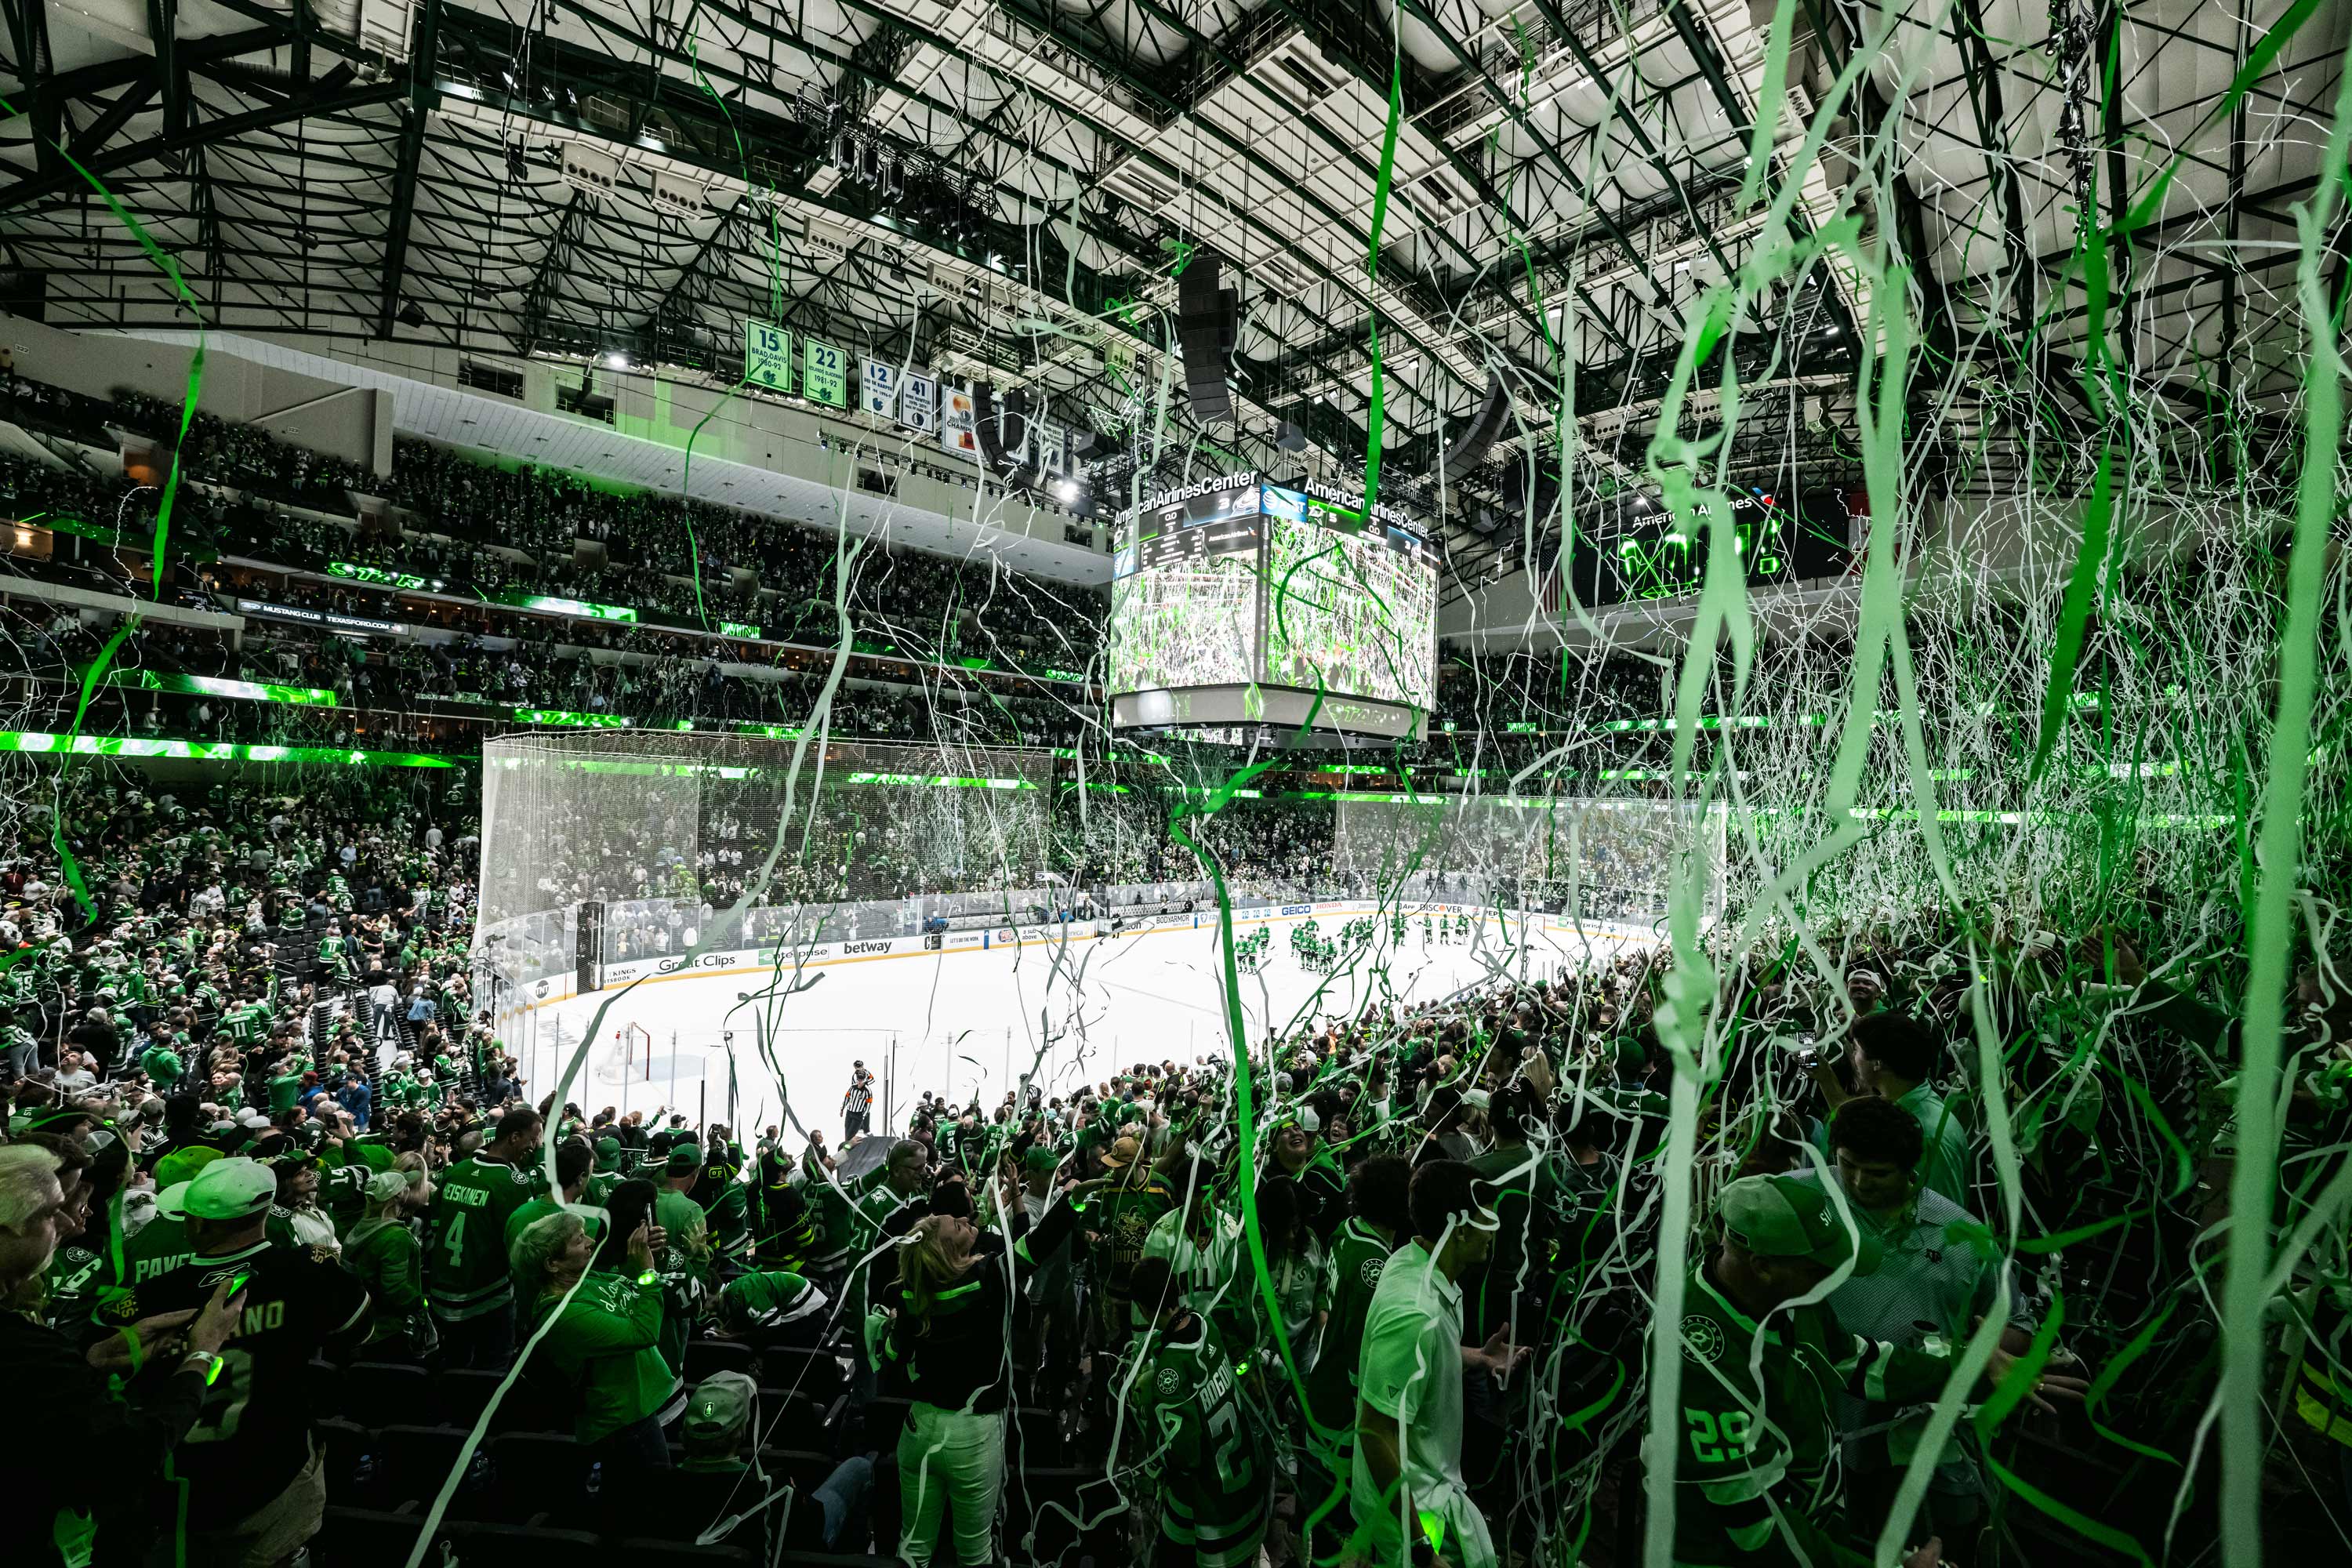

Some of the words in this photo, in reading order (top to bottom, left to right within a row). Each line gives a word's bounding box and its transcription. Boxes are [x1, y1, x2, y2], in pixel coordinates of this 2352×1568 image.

[760, 329, 779, 351] 15
[752, 347, 768, 358] BRAD
[768, 353, 786, 364] DAVIS
[816, 347, 836, 369] 22
[815, 375, 837, 387] 1981-92
[912, 381, 925, 396] 41
[1218, 497, 1230, 510] 3
[1329, 513, 1338, 523] 5
[263, 605, 300, 618] MUSTANG
[301, 612, 321, 620] CLUB
[326, 615, 390, 630] TEXASFORD.COM
[241, 848, 250, 858] 14
[1282, 906, 1311, 916] GEICO
[1420, 903, 1462, 913] DISCOVER
[1156, 915, 1190, 924] BODYARMOR
[327, 942, 336, 953] 11
[844, 942, 892, 955] betway
[703, 955, 735, 968] Clips
[763, 949, 828, 961] enteprise
[536, 985, 549, 996] TNT
[234, 1022, 247, 1038] 11
[330, 1167, 349, 1185] 14
[443, 1182, 490, 1207] HEISKANEN
[445, 1211, 466, 1268] 4
[849, 1228, 871, 1251] 21
[676, 1276, 700, 1309] 14
[1684, 1406, 1752, 1463] 29
